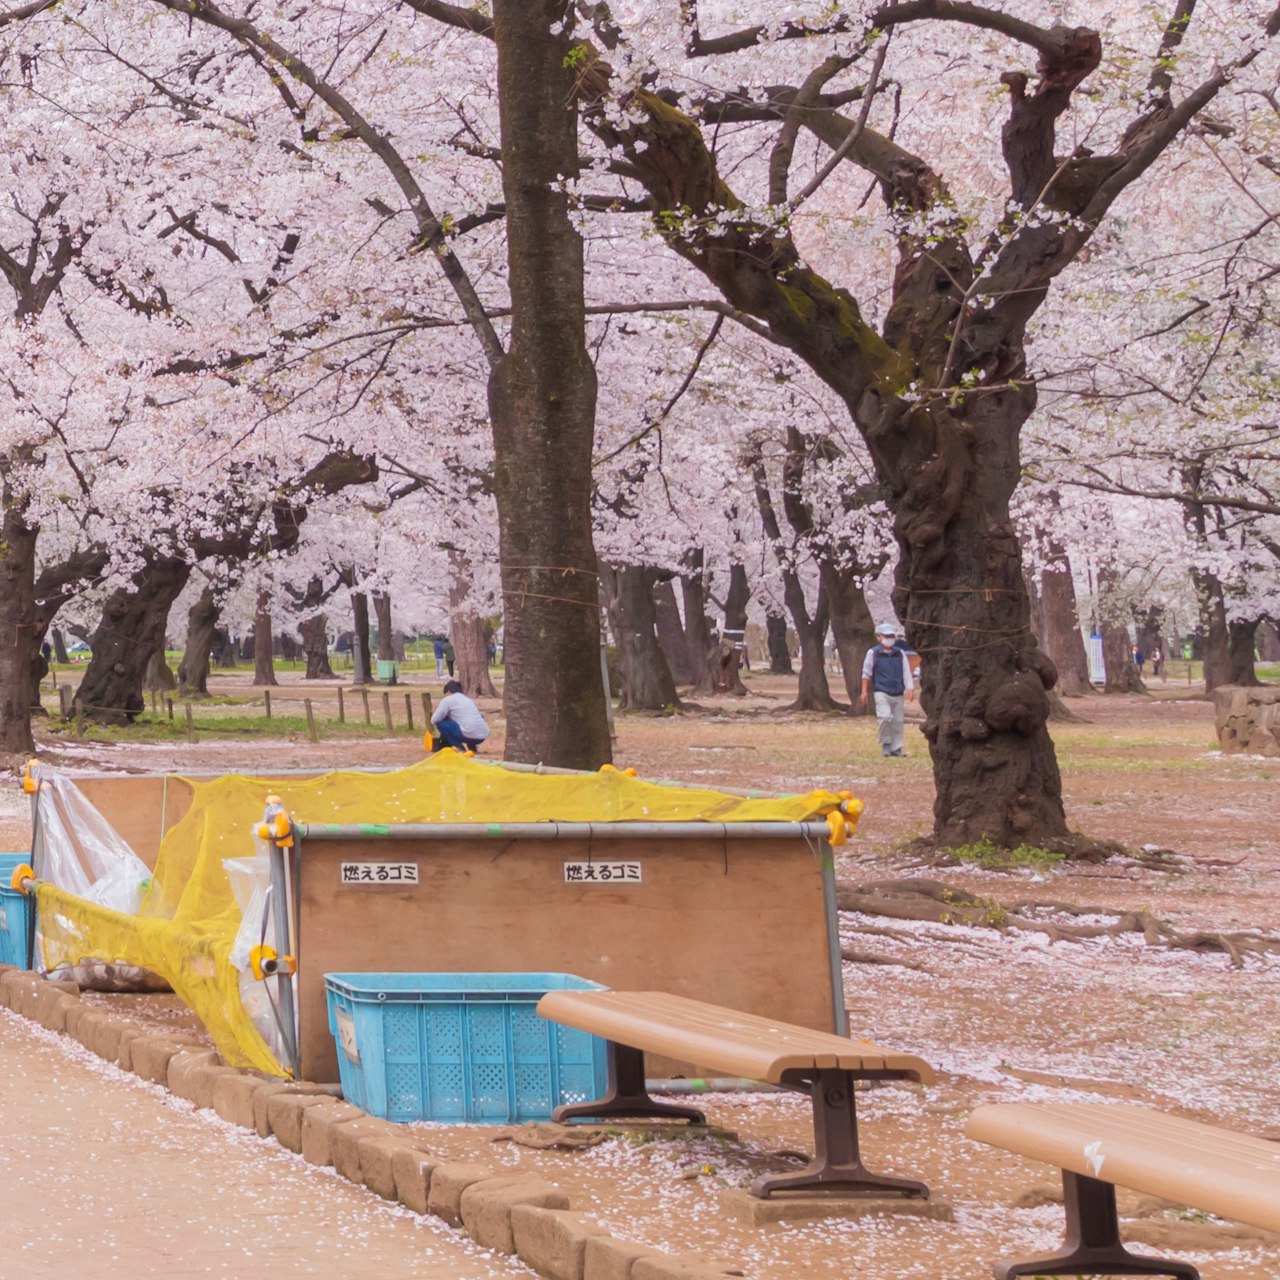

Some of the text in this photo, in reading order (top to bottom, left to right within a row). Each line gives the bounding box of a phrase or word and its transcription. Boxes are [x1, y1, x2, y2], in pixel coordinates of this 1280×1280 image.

[343, 865, 417, 881] 燃えるゴミ
[566, 864, 640, 881] 燃えるゴミ
